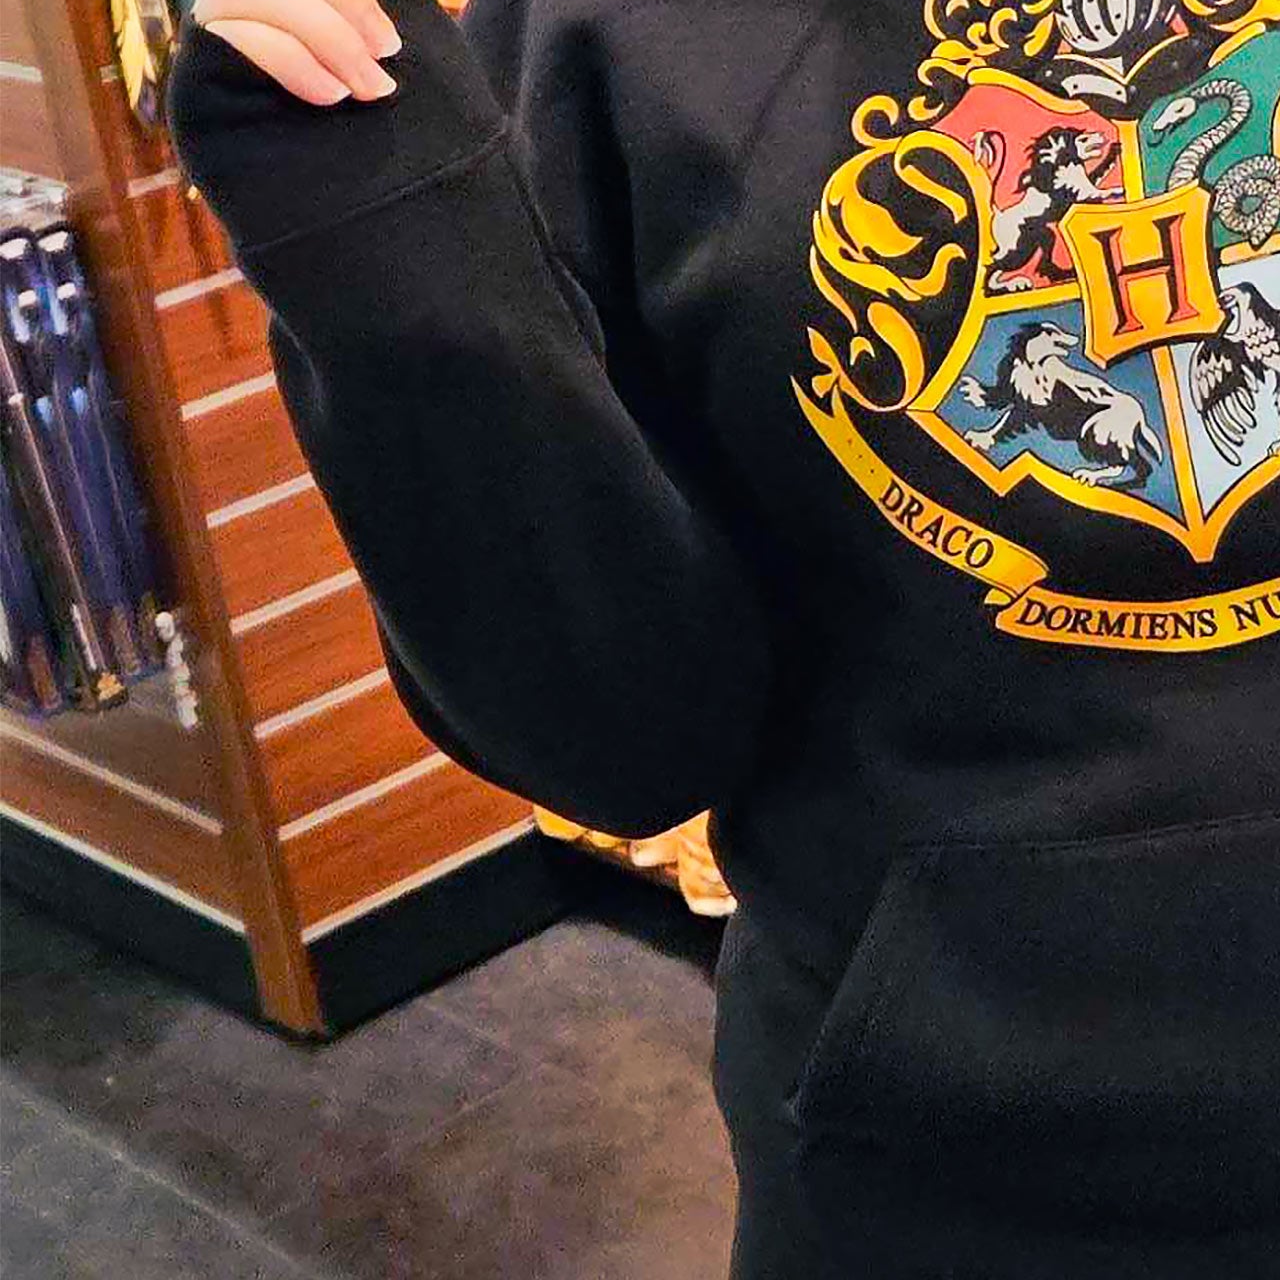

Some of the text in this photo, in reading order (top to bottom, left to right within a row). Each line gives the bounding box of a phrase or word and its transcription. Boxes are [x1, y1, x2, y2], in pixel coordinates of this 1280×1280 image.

[1089, 212, 1200, 336] H
[879, 482, 994, 568] DRACO
[1016, 599, 1218, 640] DORMIENS
